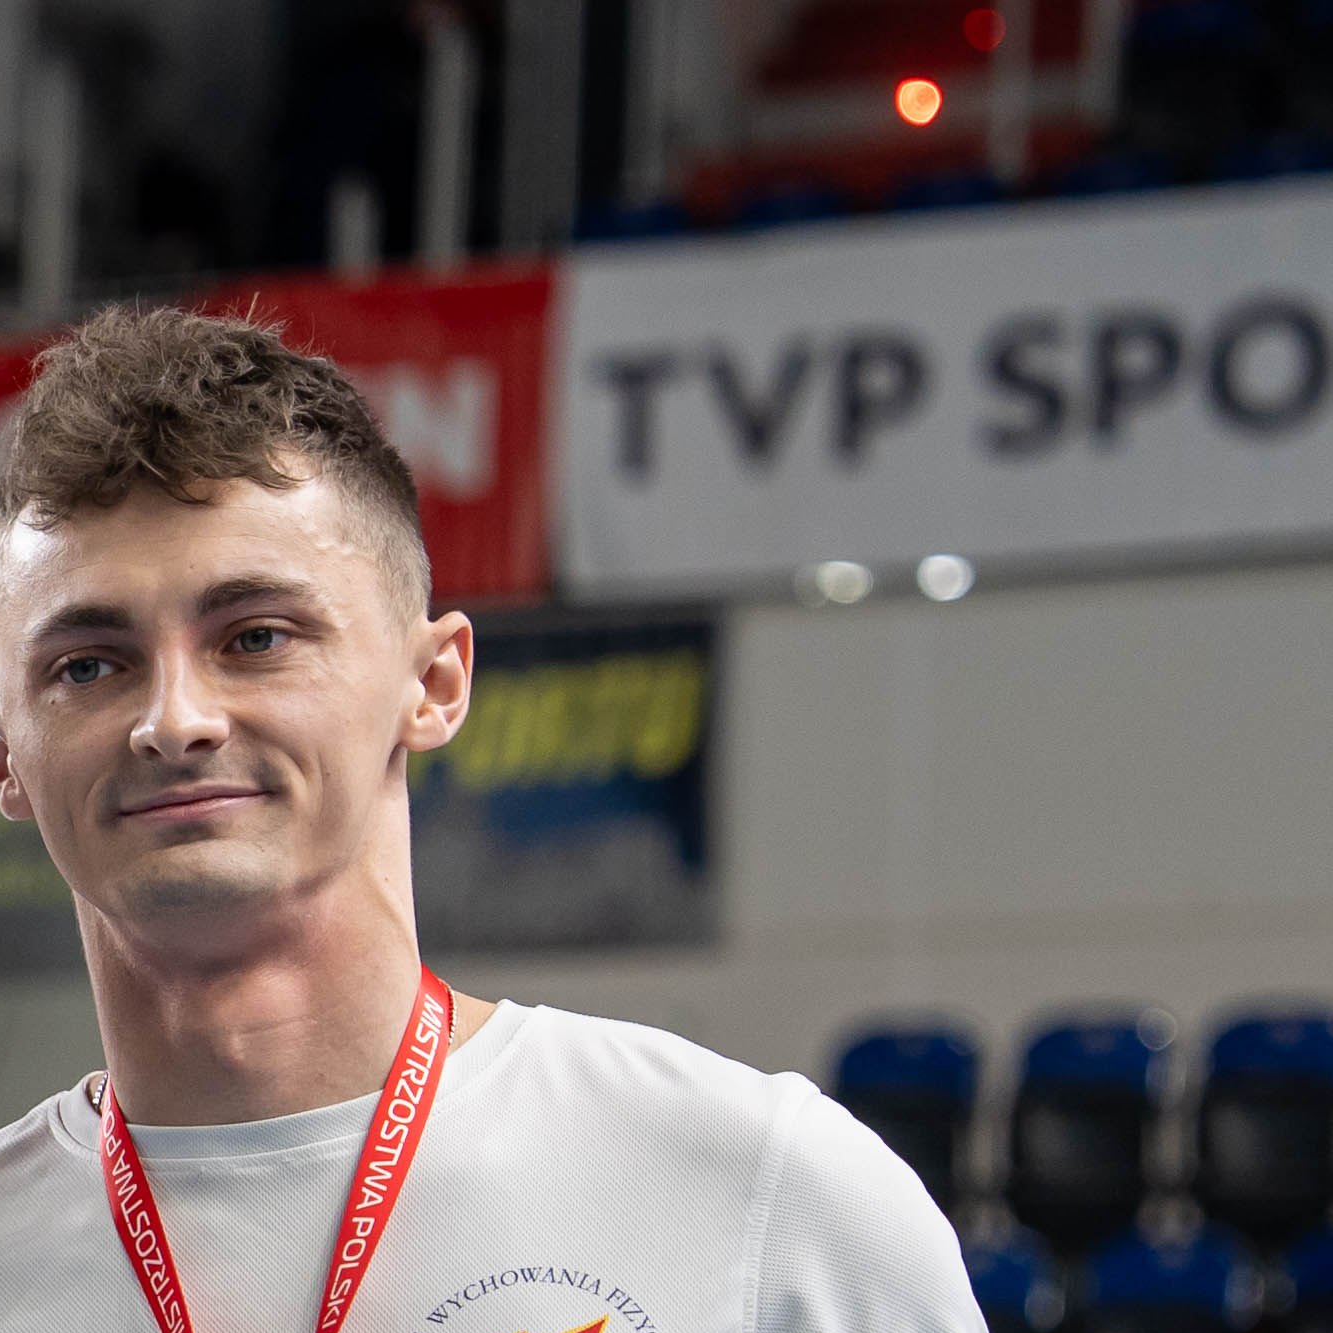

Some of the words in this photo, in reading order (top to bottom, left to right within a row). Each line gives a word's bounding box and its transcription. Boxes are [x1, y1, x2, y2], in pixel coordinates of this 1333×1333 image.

[596, 326, 928, 486] TVP
[354, 994, 445, 1210] MISTRZOSTWA
[320, 1216, 376, 1331] POLSKI
[426, 1267, 601, 1326] WYCHOWANIA
